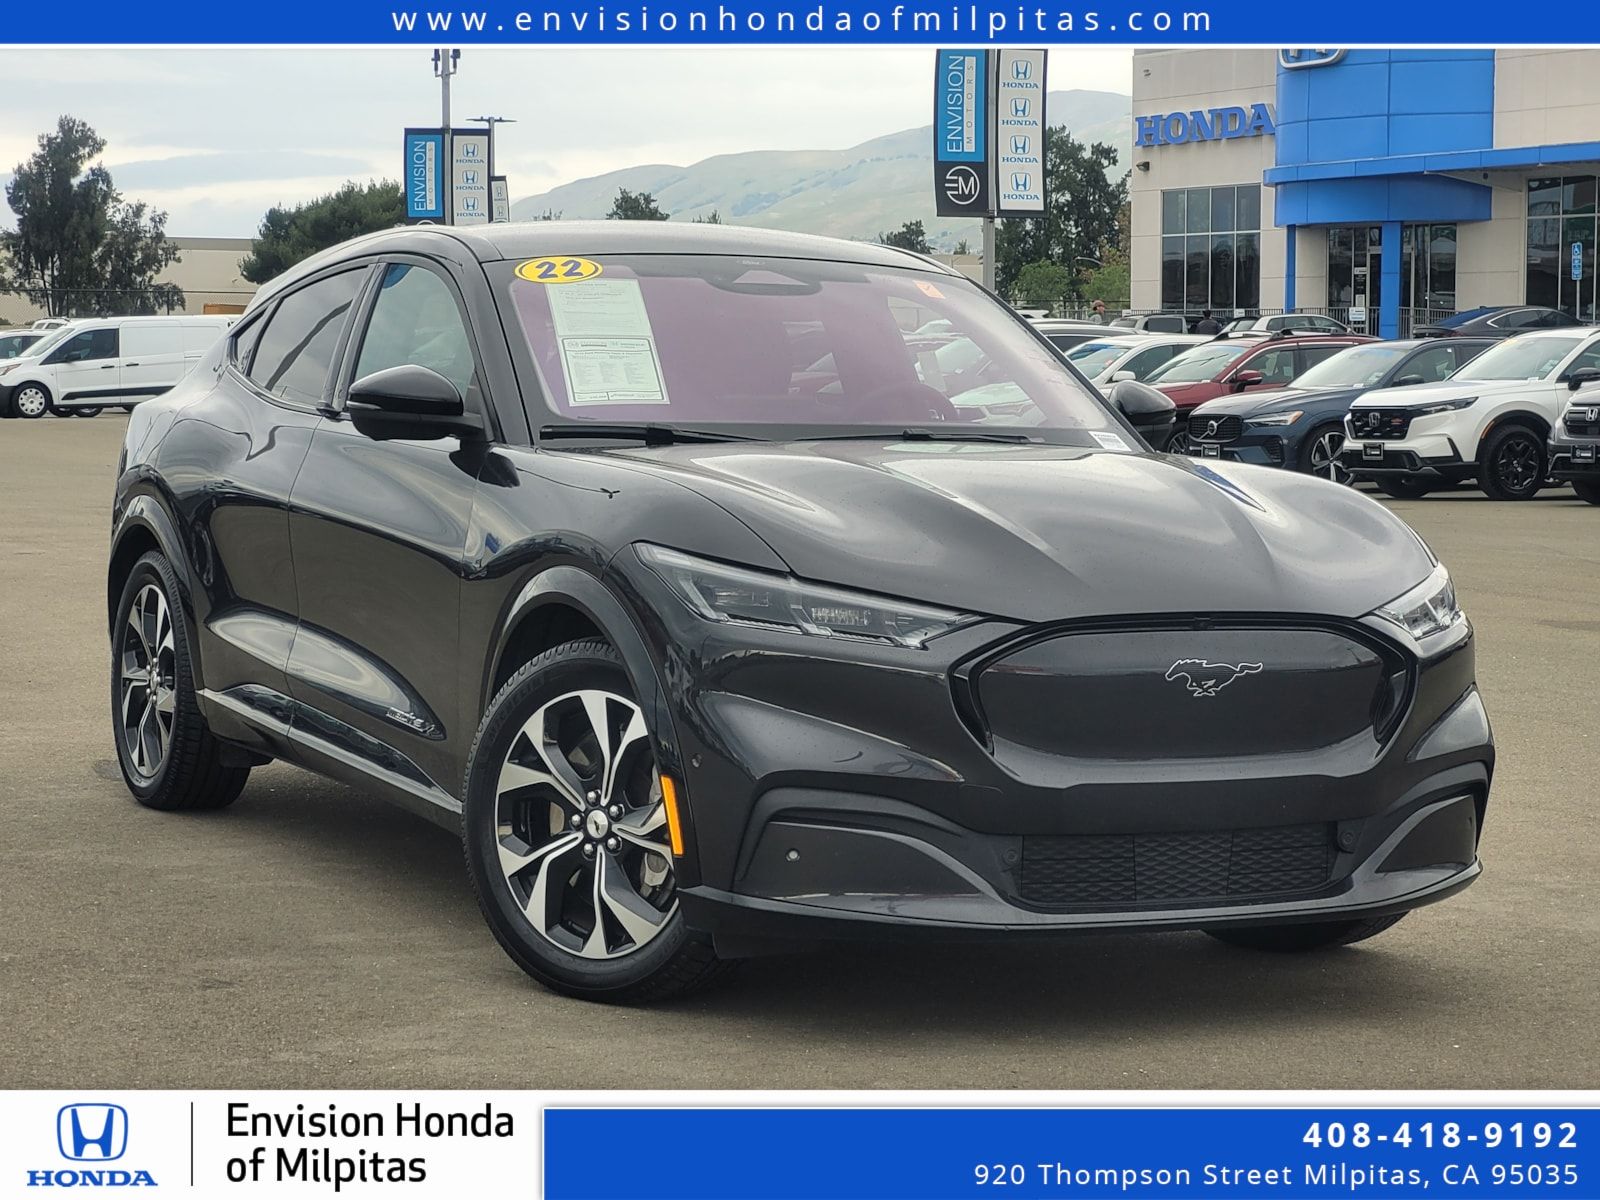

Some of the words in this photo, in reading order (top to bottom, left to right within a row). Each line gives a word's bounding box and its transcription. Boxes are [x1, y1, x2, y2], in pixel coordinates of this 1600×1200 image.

[946, 56, 964, 153] ENVISION
[966, 65, 974, 144] MOTORS
[1135, 103, 1276, 147] HONDA
[413, 141, 426, 211] ENVISION
[535, 259, 584, 279] 22
